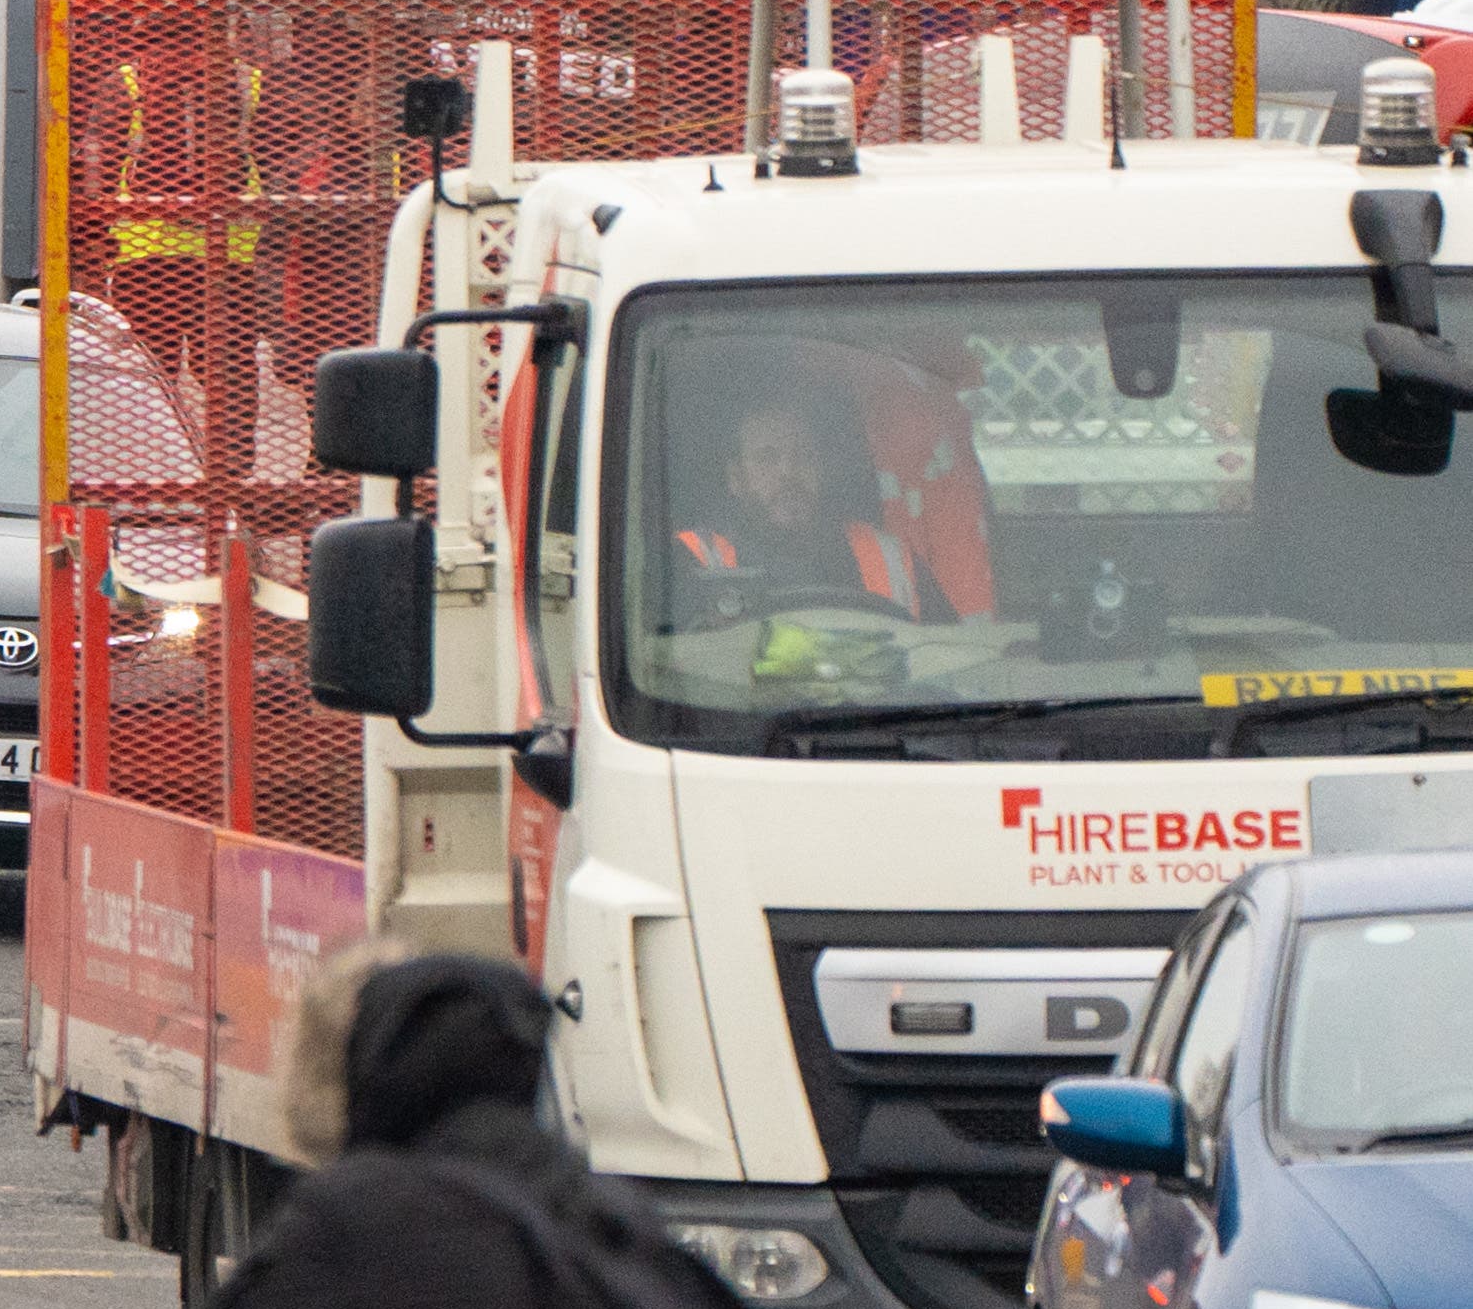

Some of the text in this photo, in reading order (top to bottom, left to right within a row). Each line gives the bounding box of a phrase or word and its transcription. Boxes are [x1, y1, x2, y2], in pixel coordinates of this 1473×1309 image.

[1029, 810, 1302, 854] HIREBASE
[1029, 862, 1230, 886] PLANT & TOOL
